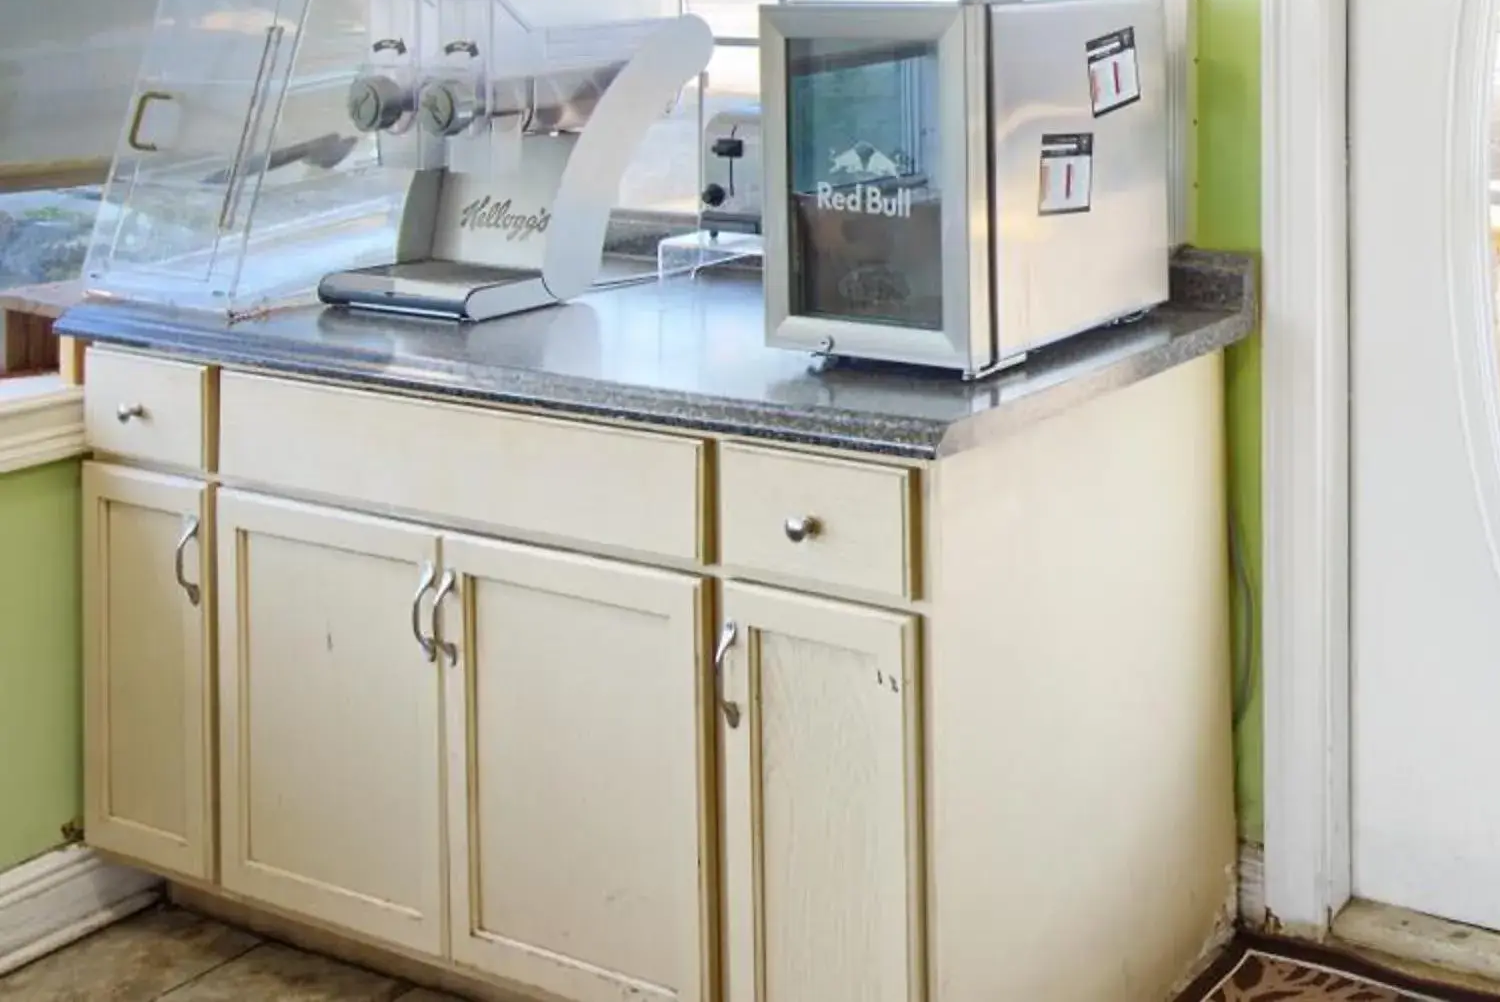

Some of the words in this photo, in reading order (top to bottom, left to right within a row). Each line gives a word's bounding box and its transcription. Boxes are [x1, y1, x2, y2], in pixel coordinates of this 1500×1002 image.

[460, 195, 551, 241] Kellogg's
[817, 181, 863, 212] Red
[866, 185, 911, 218] Bull
